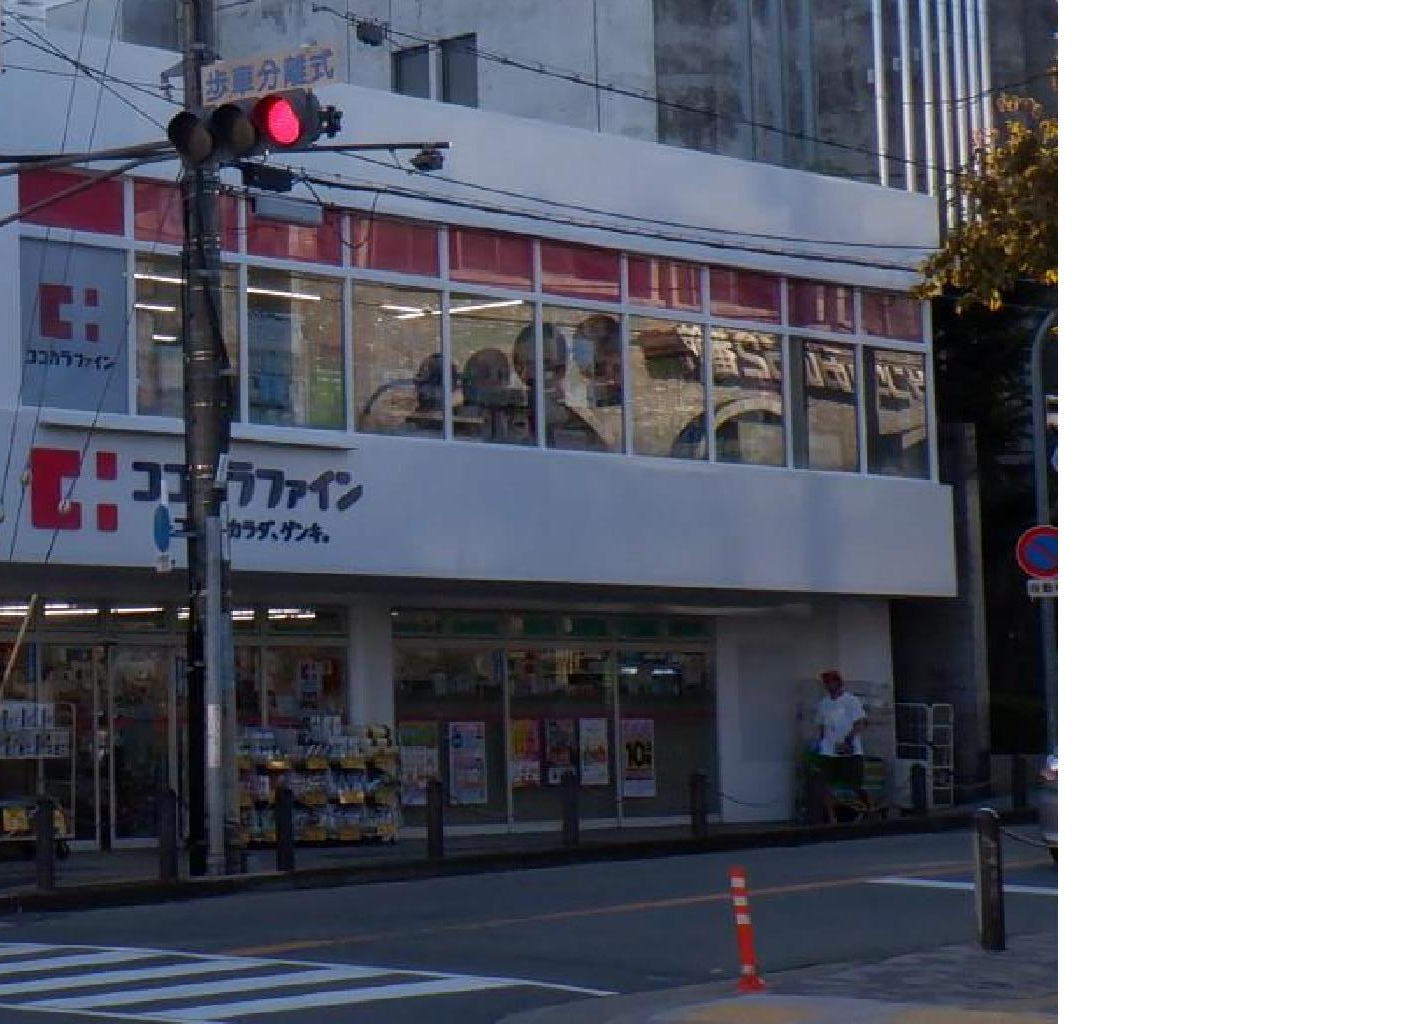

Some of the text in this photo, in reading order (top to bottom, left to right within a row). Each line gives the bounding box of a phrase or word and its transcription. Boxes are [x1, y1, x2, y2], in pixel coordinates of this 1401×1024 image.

[21, 349, 118, 371] ココカラファイン
[132, 461, 364, 511] ココラファイン
